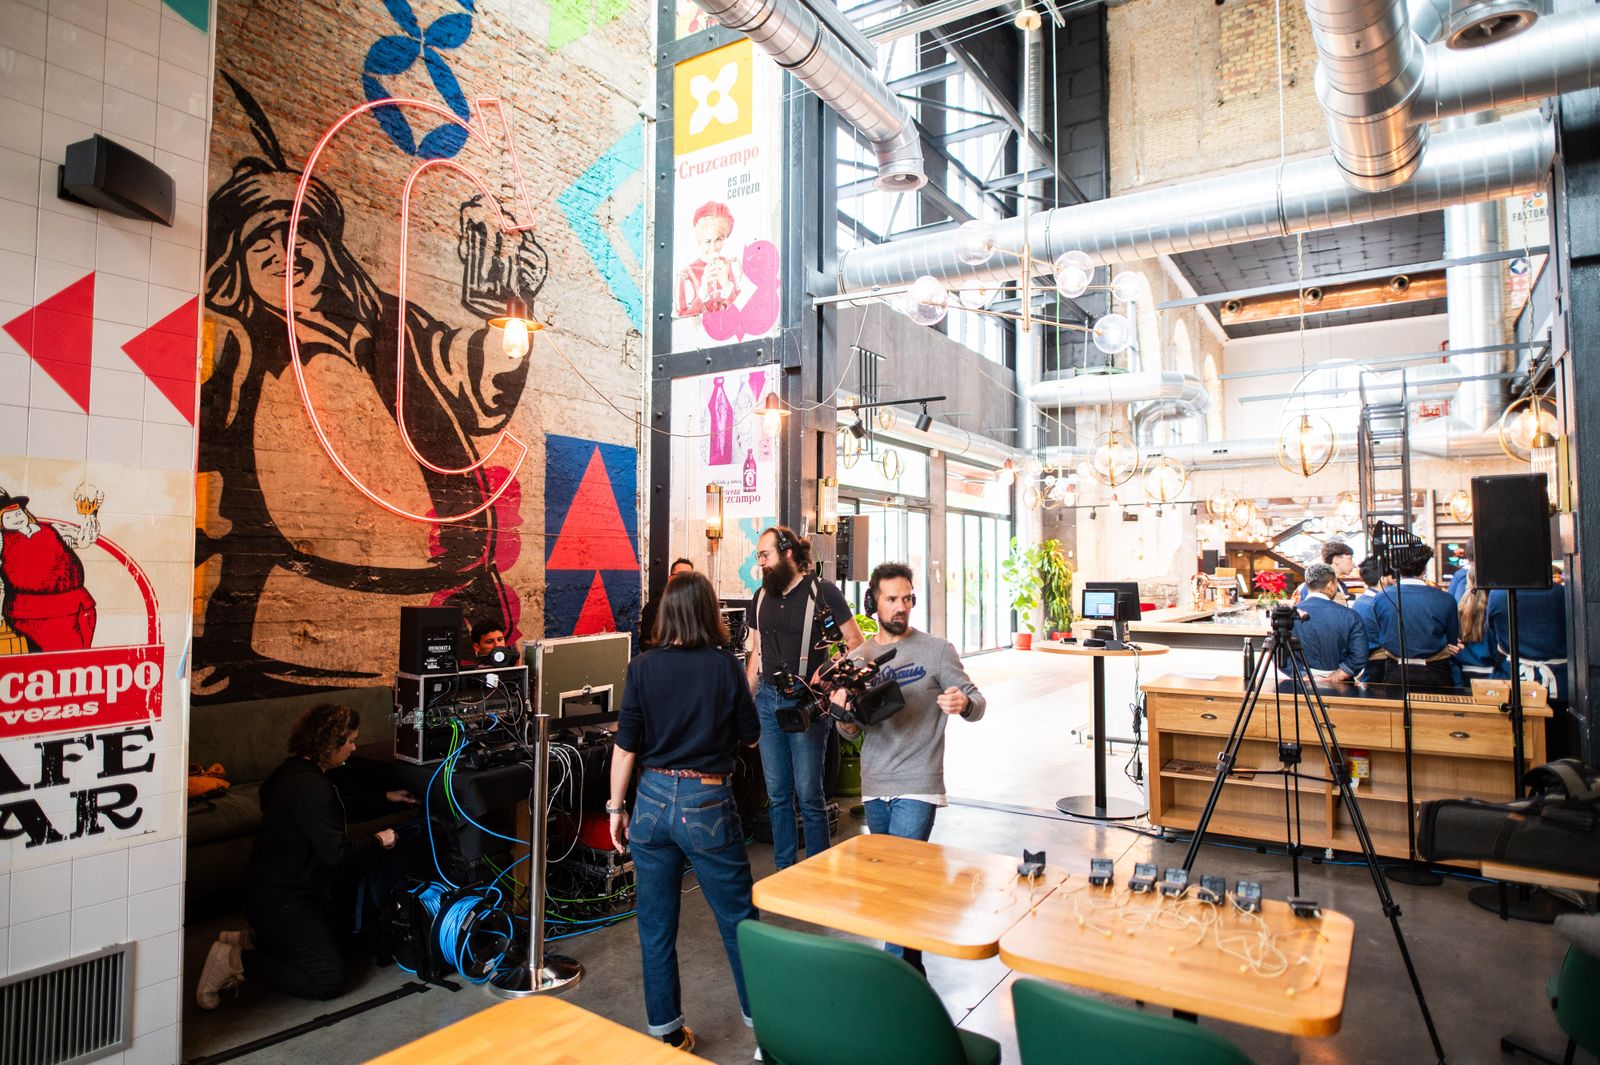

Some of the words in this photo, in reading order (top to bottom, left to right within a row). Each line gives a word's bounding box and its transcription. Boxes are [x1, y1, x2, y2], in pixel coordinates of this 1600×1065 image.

[679, 146, 760, 180] Cruzcampo
[727, 176, 738, 188] es
[740, 170, 751, 185] mi
[727, 181, 760, 199] cerveza
[726, 494, 761, 504] zcampo
[0, 661, 161, 704] campo
